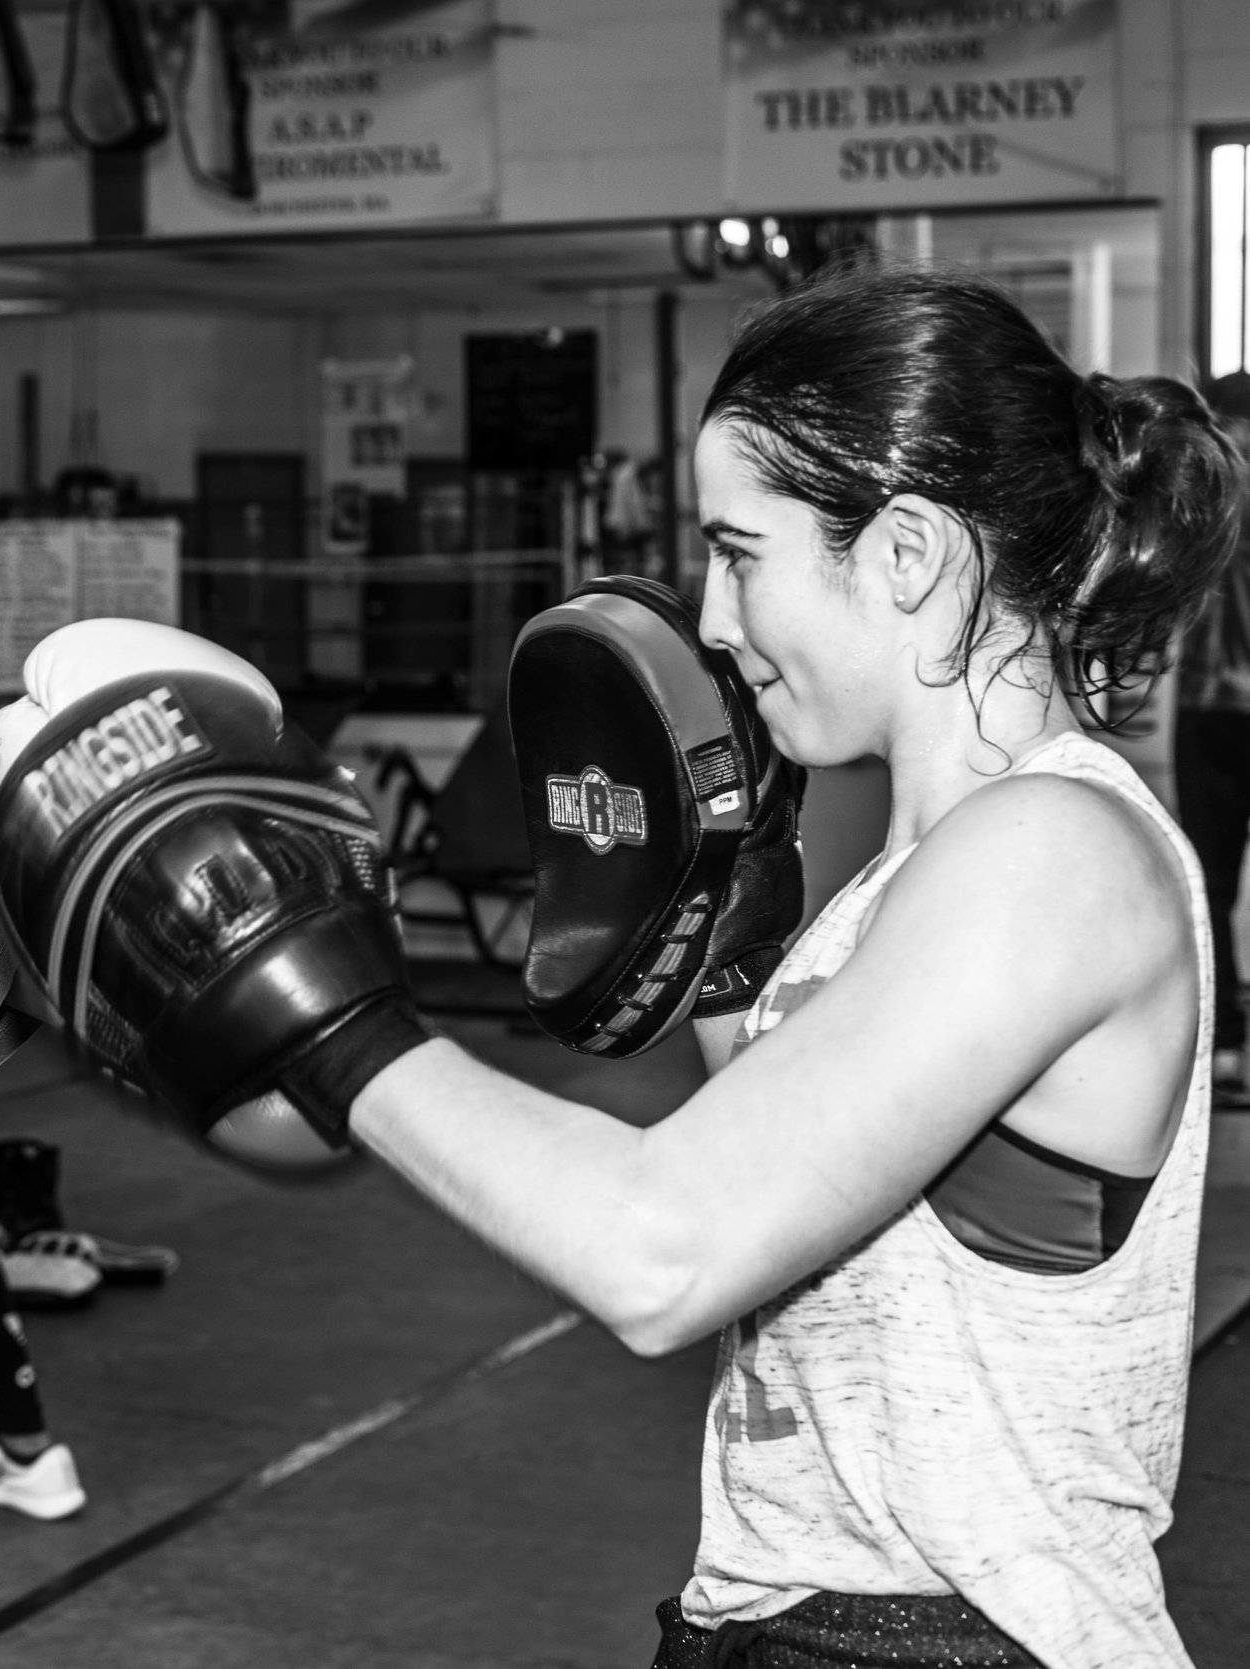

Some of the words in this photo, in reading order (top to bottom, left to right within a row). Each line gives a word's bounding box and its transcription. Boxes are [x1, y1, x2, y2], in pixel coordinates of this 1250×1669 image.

[849, 36, 987, 67] SPONSOR
[754, 86, 856, 132] THE
[865, 75, 1086, 127] BLARNEY
[838, 132, 1002, 183] STONE
[24, 684, 205, 838] RINGSIDE
[550, 784, 581, 826] RING
[584, 781, 613, 838] R
[701, 983, 717, 993] OM
